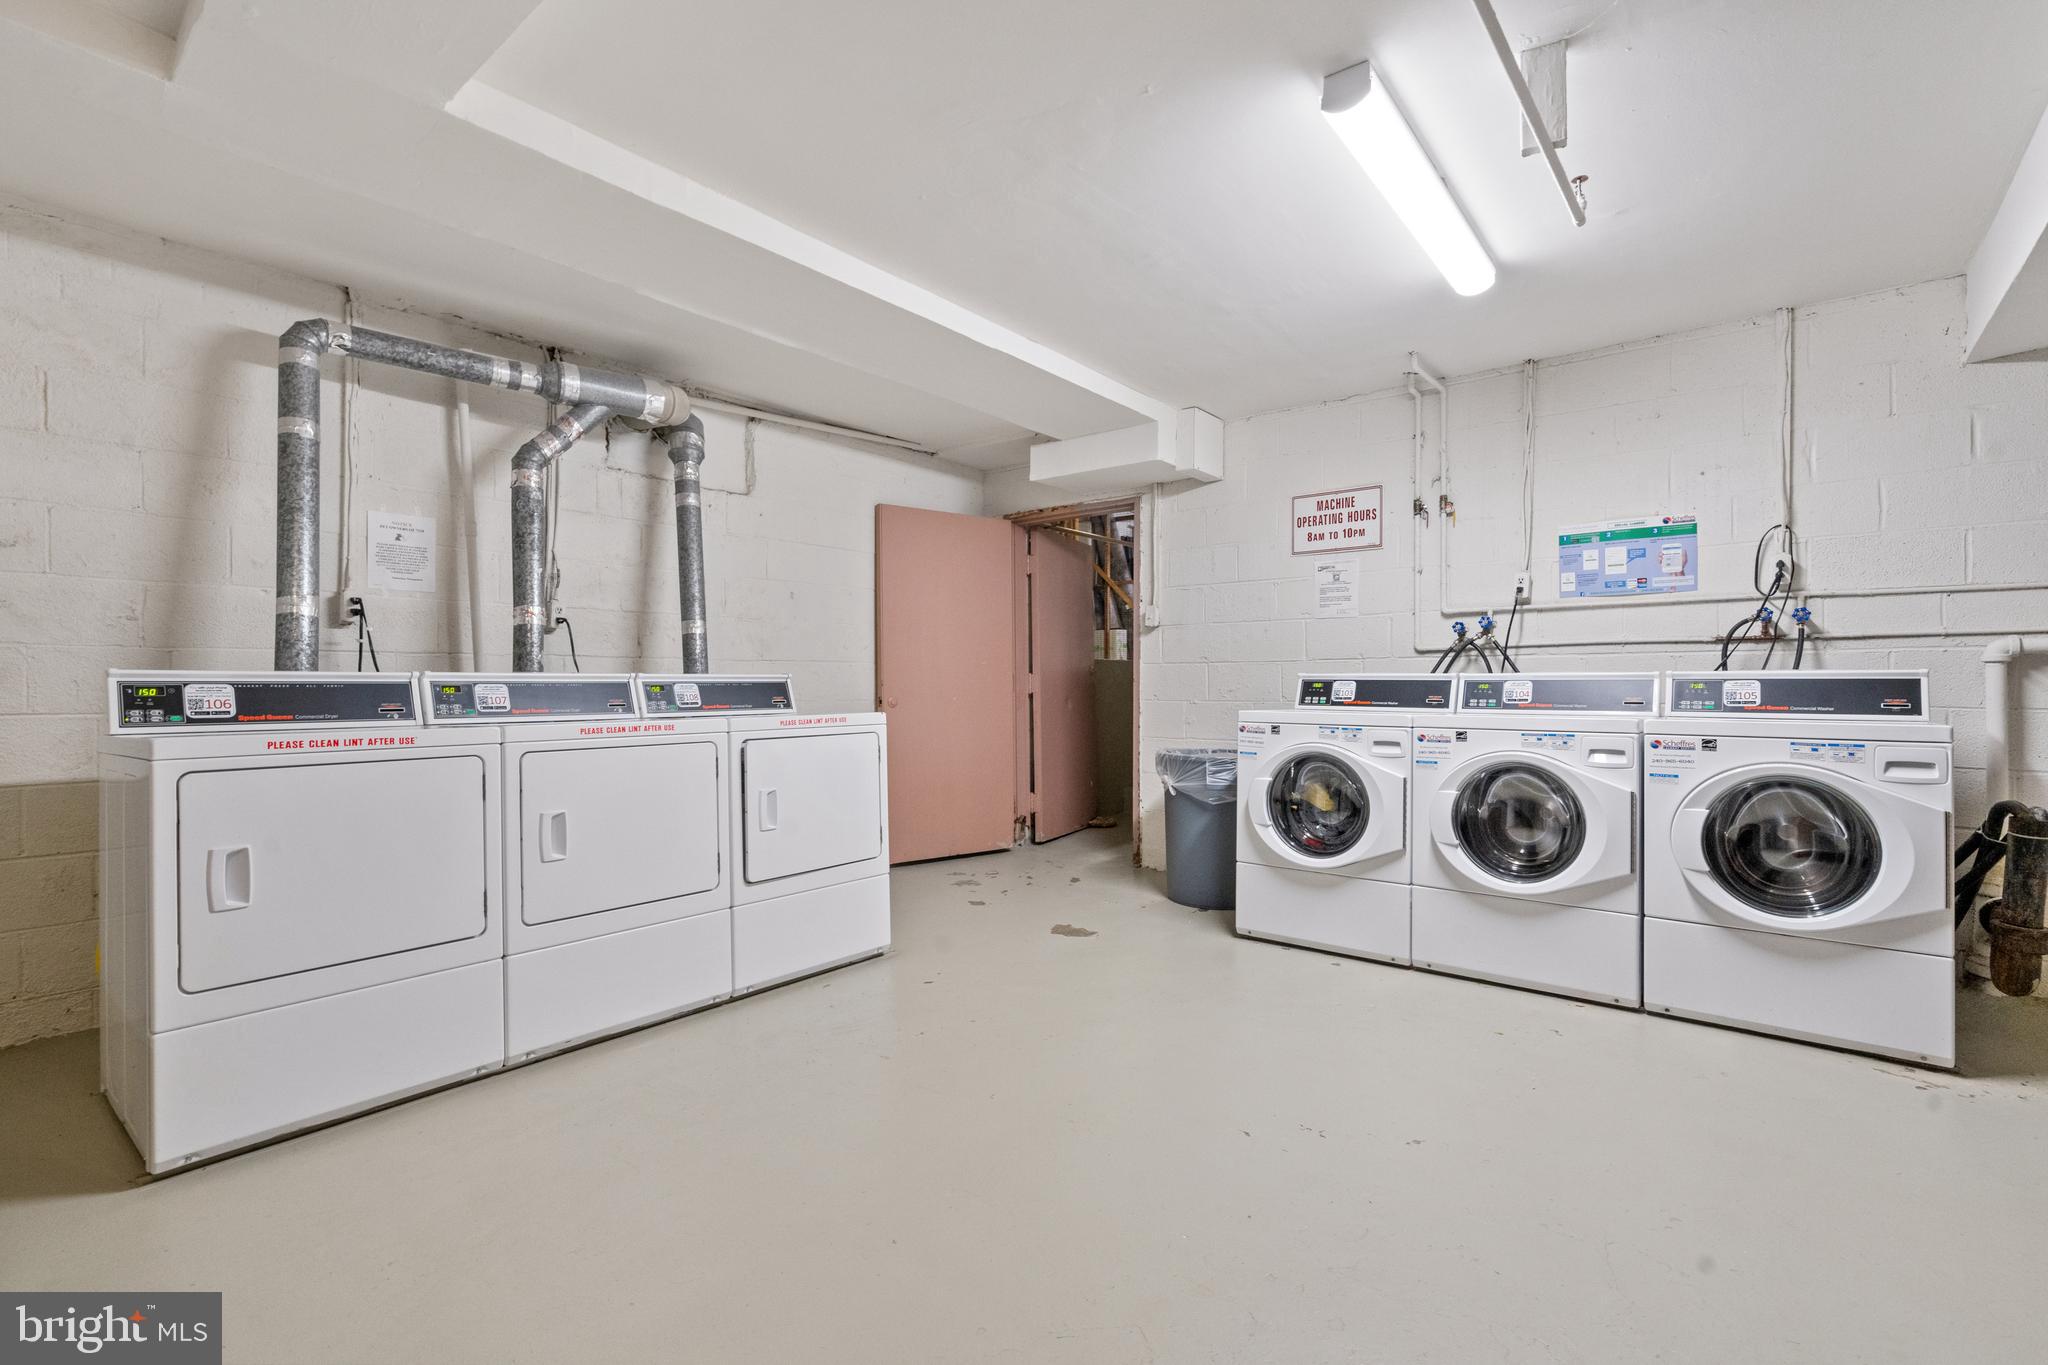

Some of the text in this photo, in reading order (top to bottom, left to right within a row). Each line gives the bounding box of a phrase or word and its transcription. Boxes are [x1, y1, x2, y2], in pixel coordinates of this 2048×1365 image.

[1316, 496, 1356, 512] MACHINE
[1296, 508, 1377, 528] OPERATING HOURS
[1307, 528, 1366, 542] 8AM TO 10PM
[206, 699, 232, 709] 106
[268, 737, 415, 750] PLEASE CLEAN LINT AFTER USE
